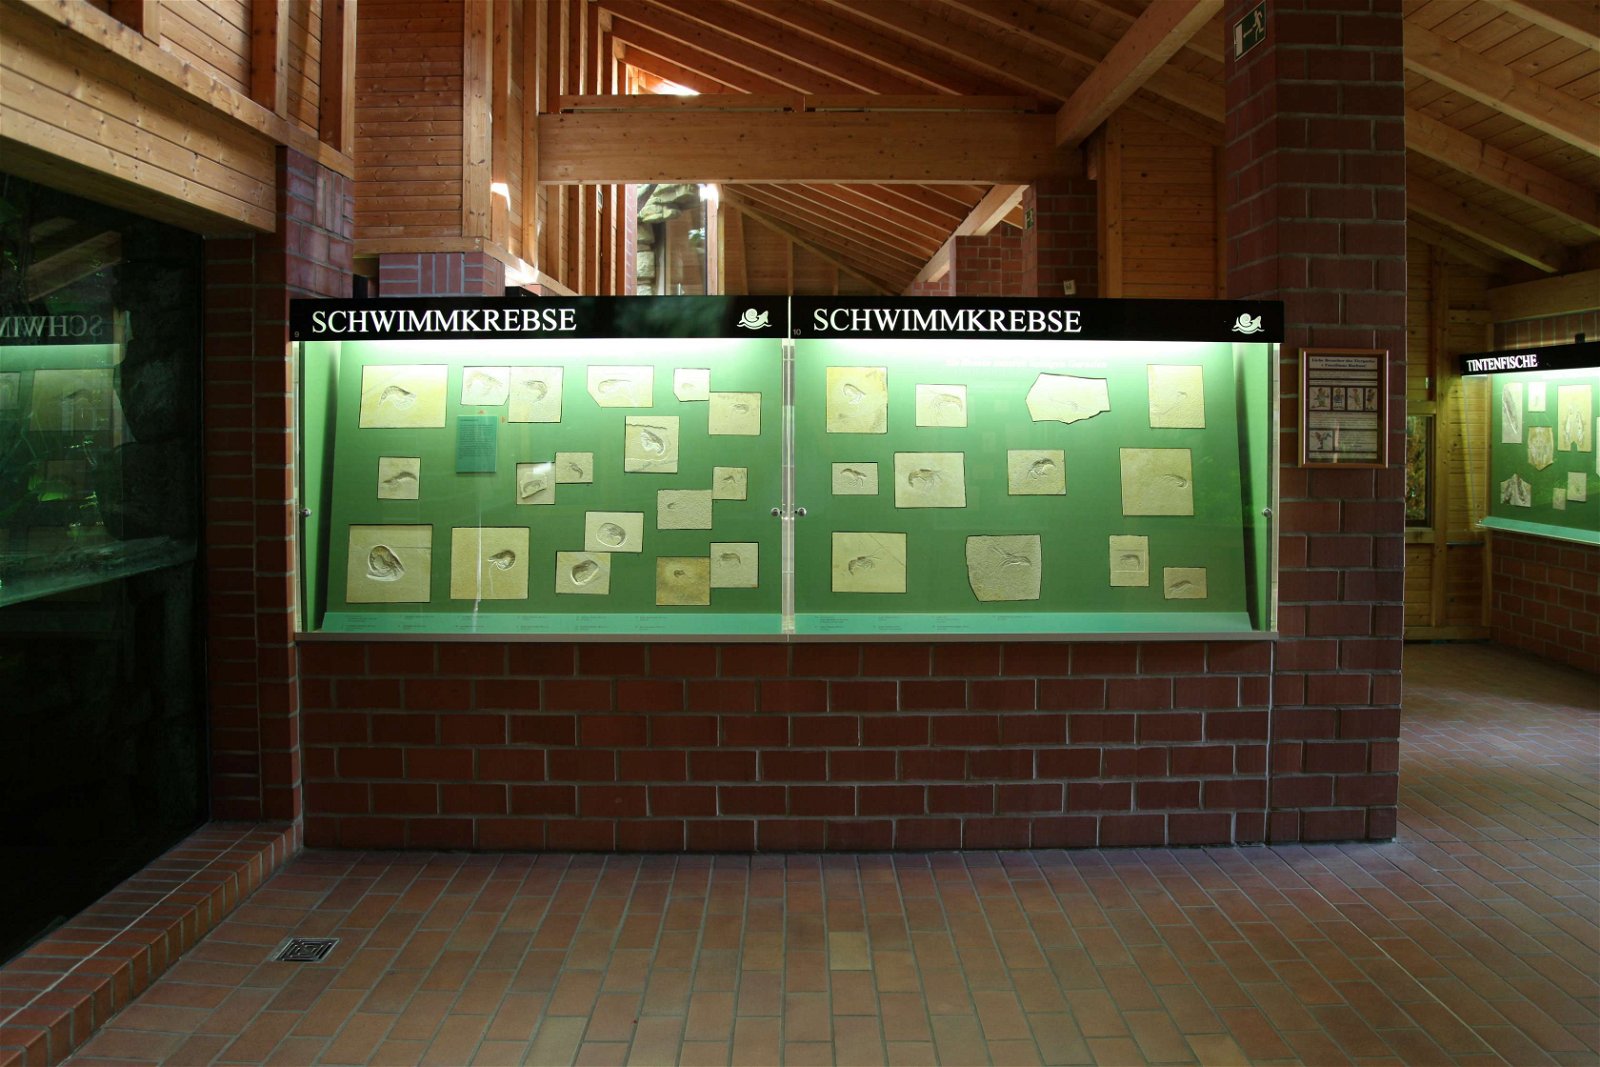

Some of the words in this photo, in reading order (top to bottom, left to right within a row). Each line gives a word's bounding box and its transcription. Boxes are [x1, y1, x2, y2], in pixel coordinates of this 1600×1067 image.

[312, 308, 577, 333] SCHWIMMKREBSE
[813, 308, 1082, 333] SCHWIMMKREBSE
[792, 328, 802, 336] 10
[1466, 354, 1539, 372] TINTENFISCHE
